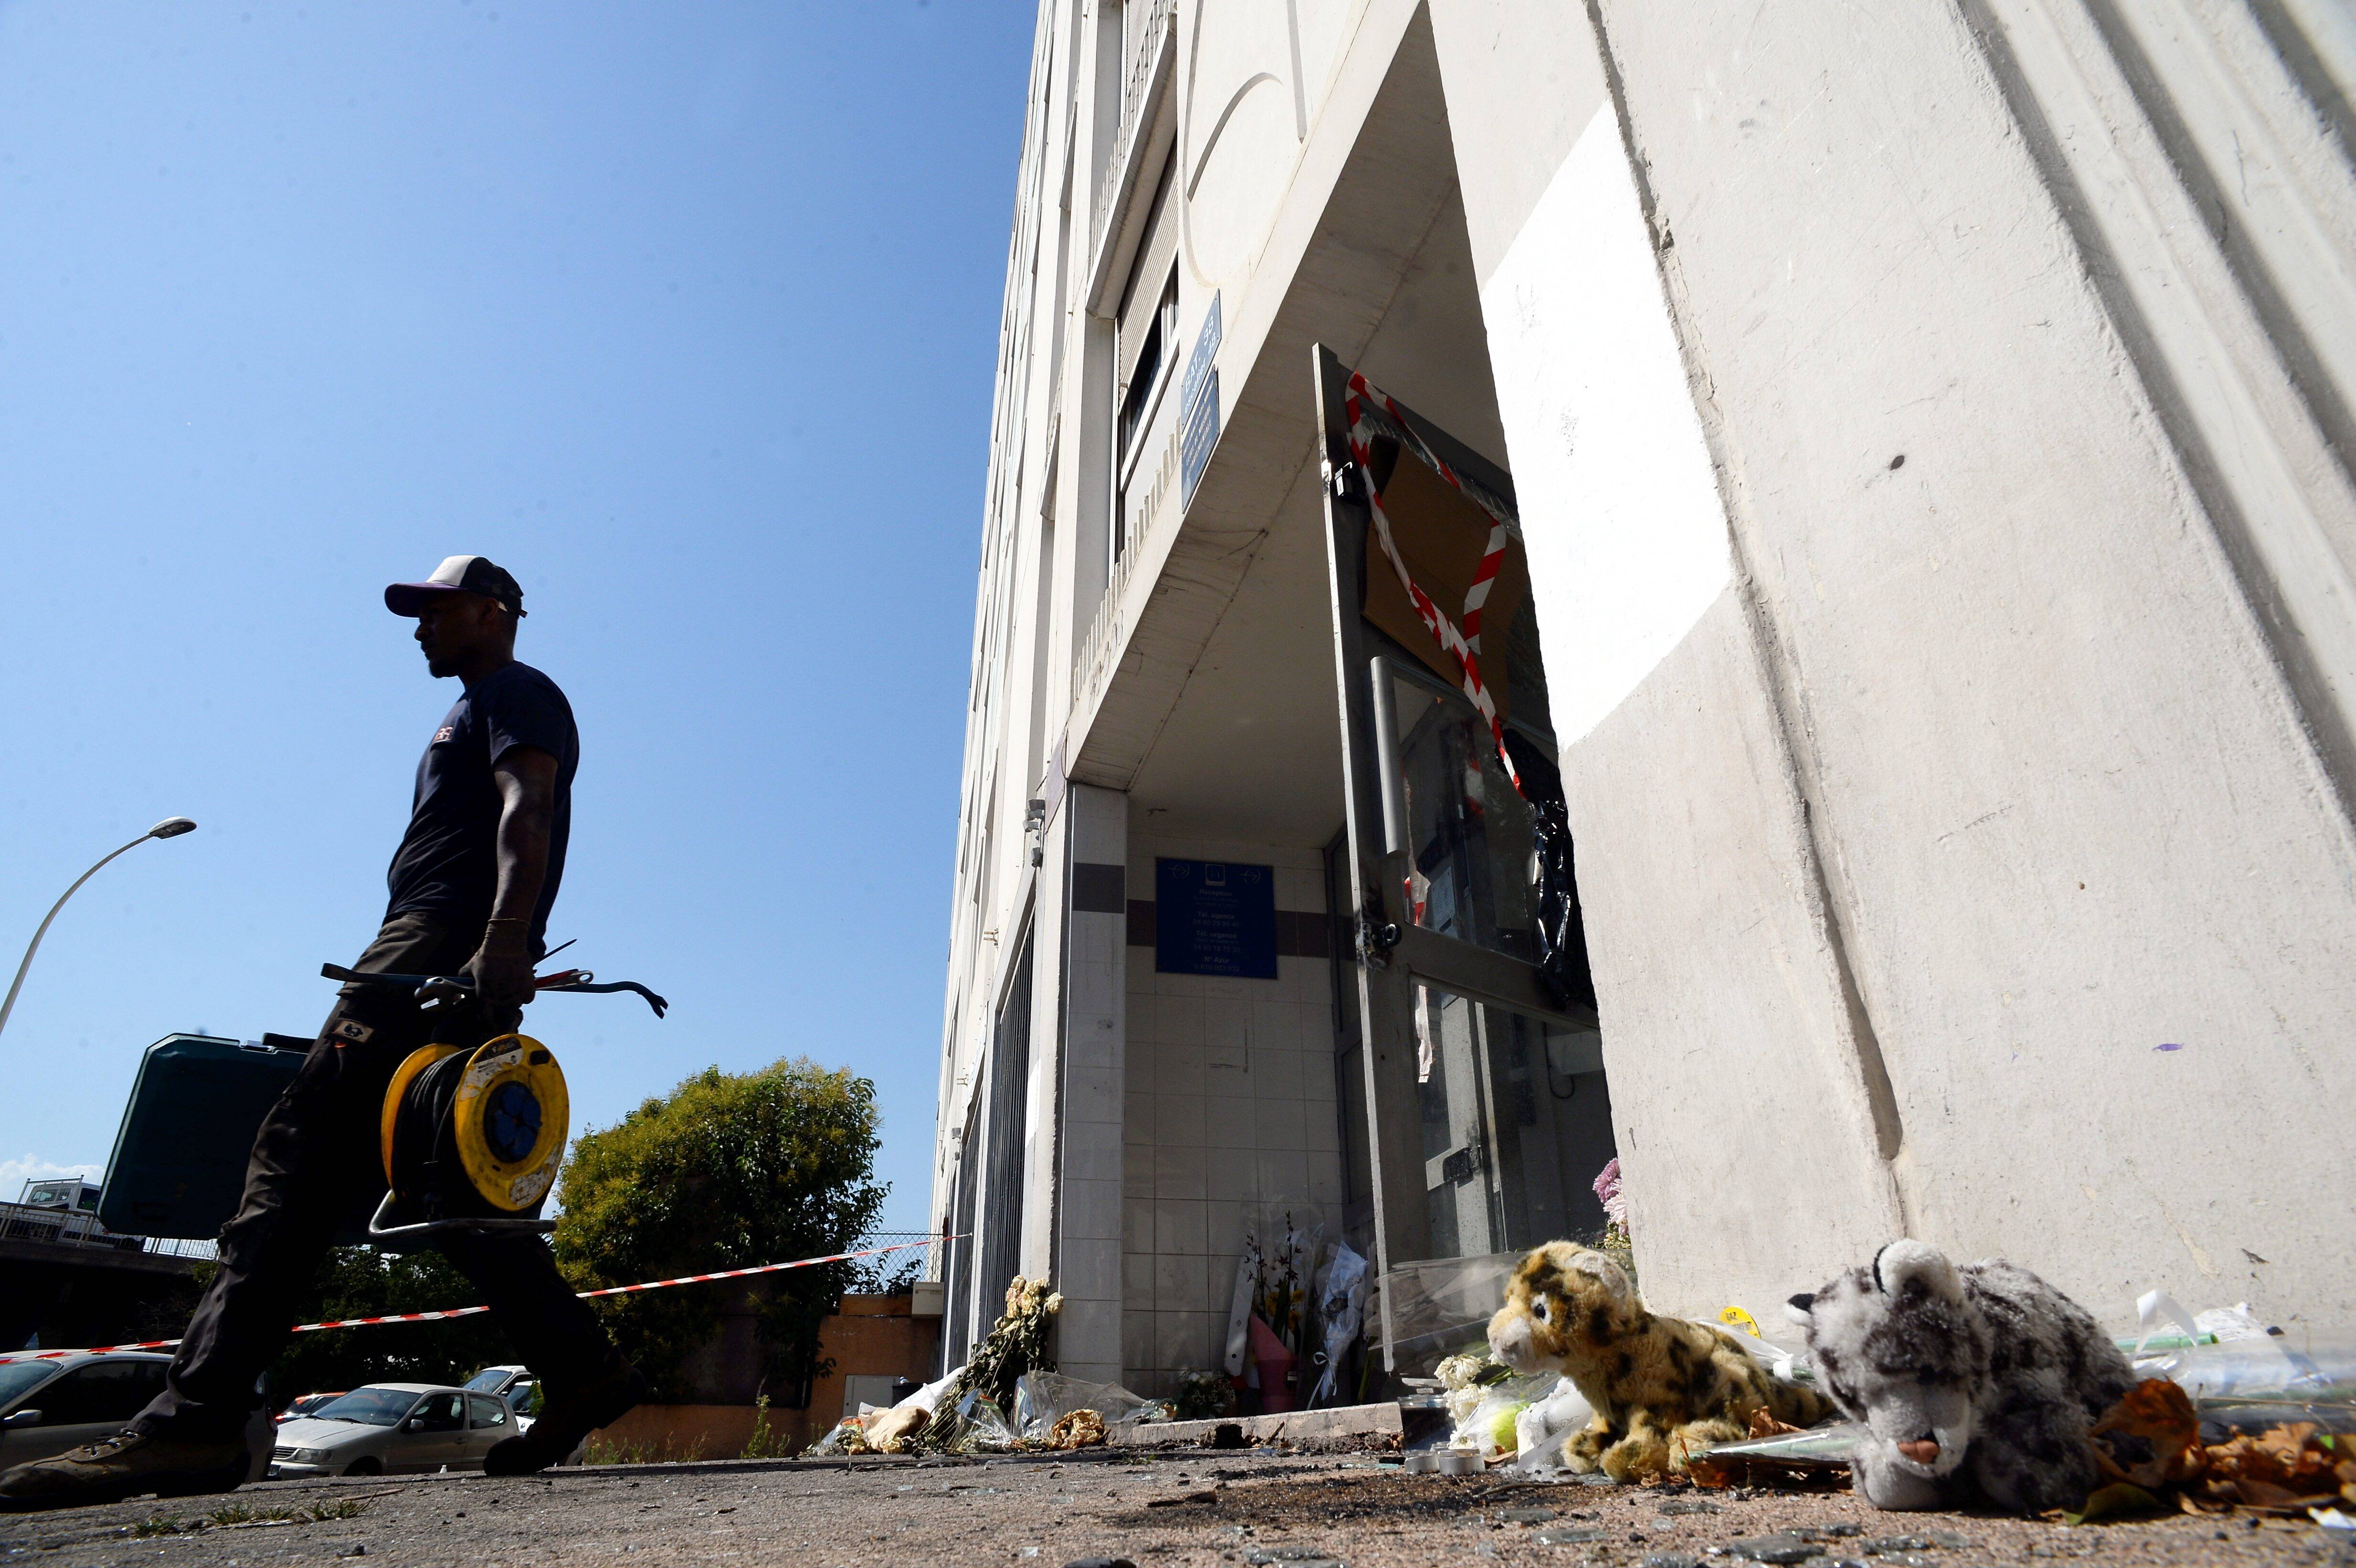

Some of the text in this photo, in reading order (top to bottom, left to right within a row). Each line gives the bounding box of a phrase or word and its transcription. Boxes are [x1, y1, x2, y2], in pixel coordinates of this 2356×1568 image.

[1185, 357, 1206, 414] escalier
[1208, 332, 1216, 354] 48
[1186, 316, 1214, 394] BAT. 38
[1199, 889, 1233, 897] Réception
